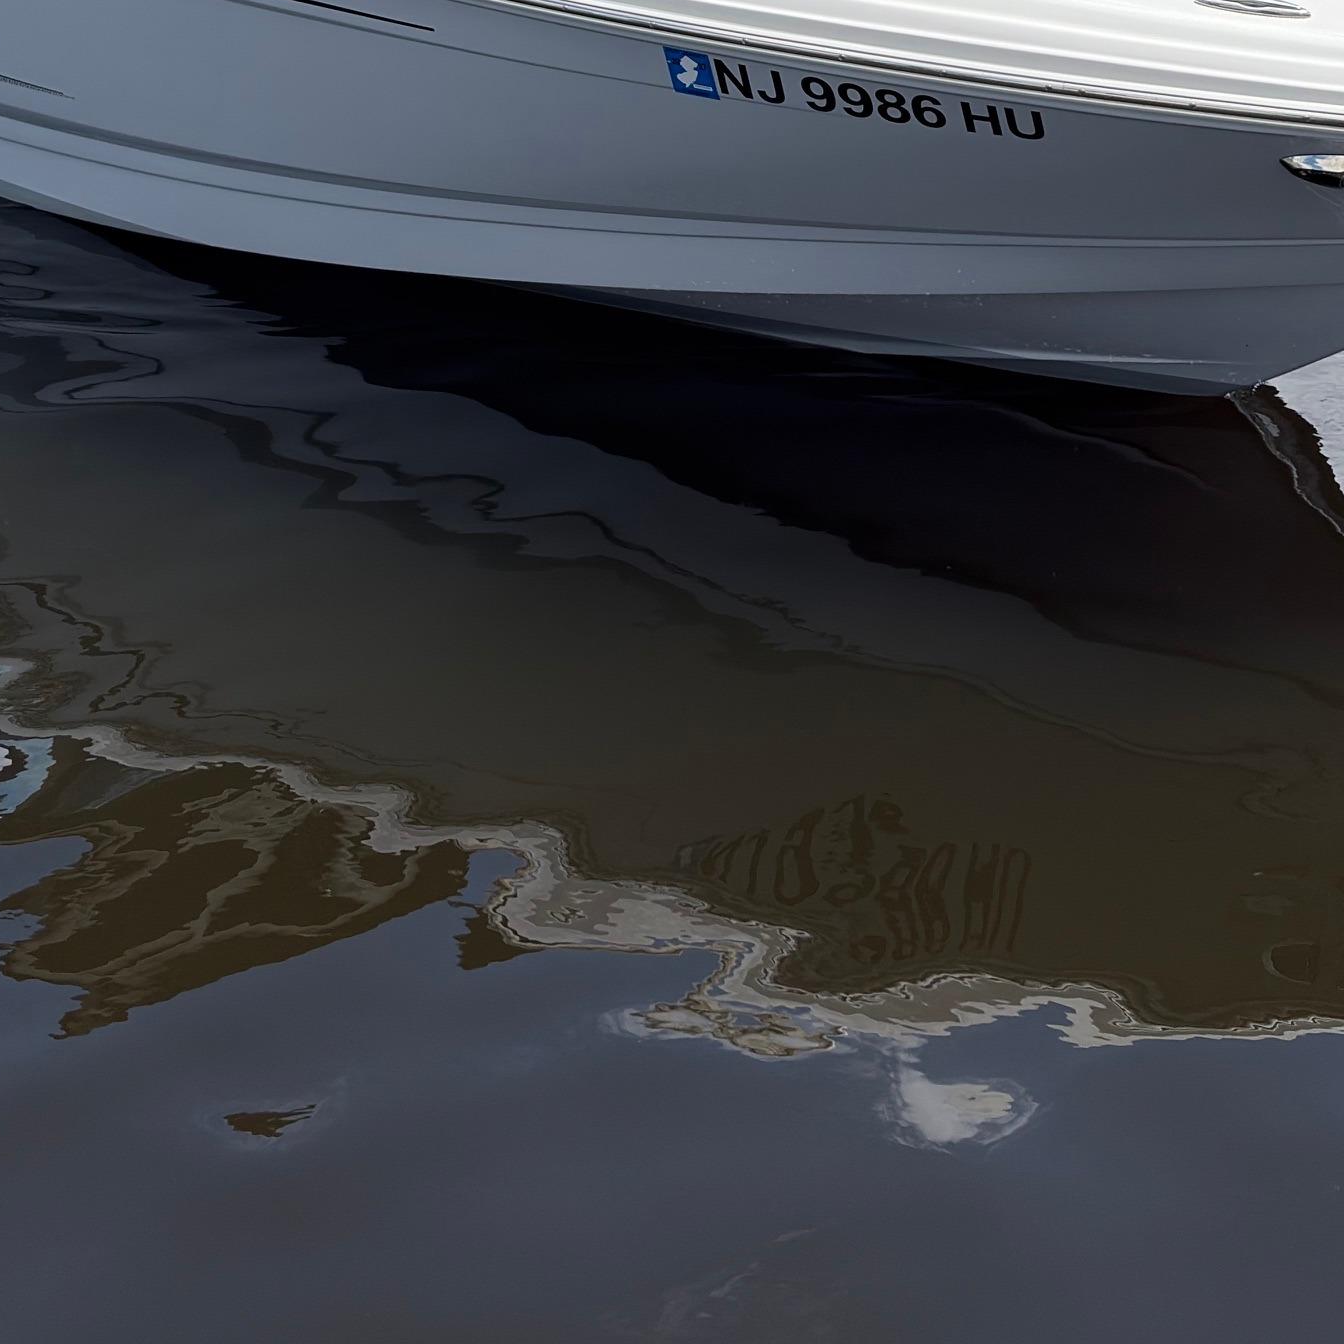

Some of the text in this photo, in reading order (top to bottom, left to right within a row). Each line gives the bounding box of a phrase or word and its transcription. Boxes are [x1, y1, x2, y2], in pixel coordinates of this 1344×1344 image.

[713, 58, 1045, 140] NJ 9986 HU
